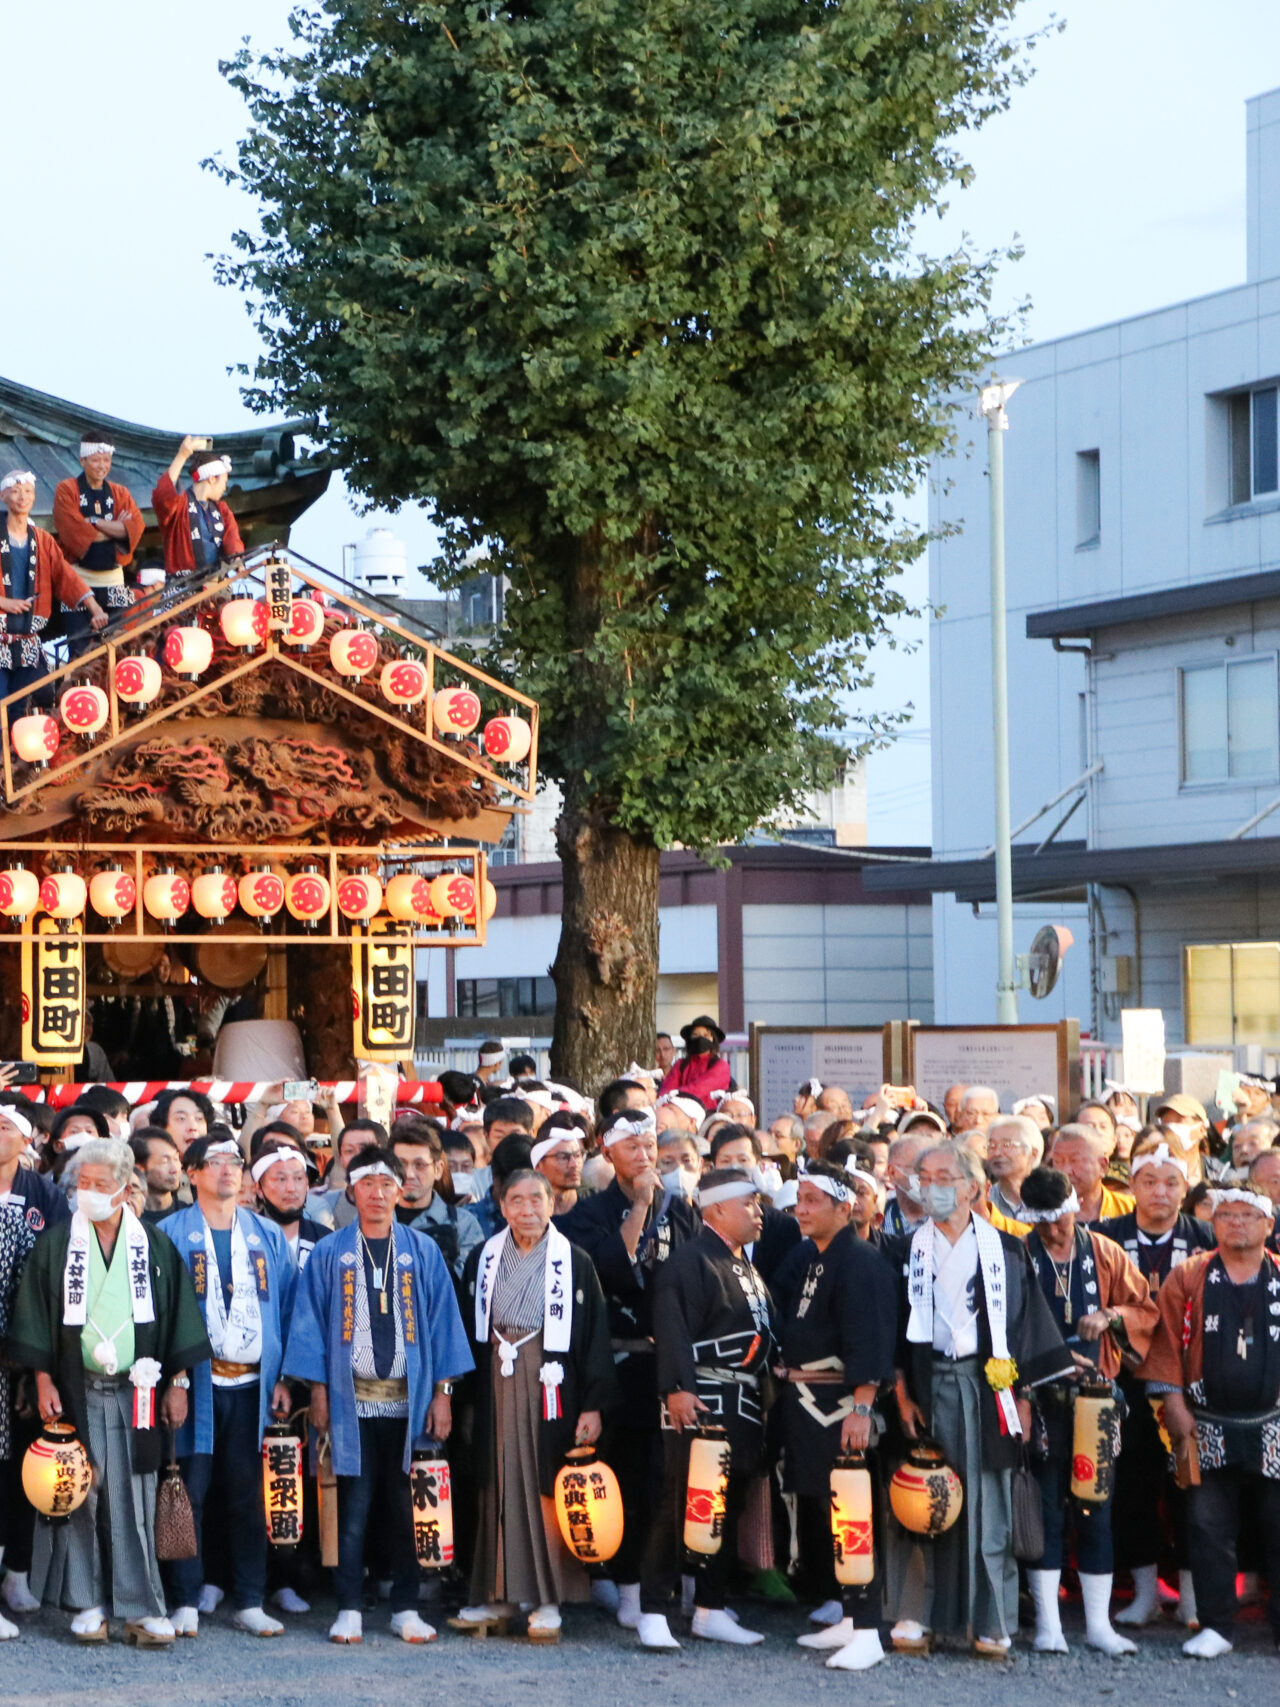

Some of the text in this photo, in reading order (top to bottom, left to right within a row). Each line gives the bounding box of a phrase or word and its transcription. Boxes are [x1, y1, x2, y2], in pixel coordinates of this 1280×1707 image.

[271, 567, 291, 623] 中田町
[550, 1260, 564, 1320] てら町
[269, 1444, 299, 1540] 若衆頭
[411, 1468, 442, 1562] 木頭
